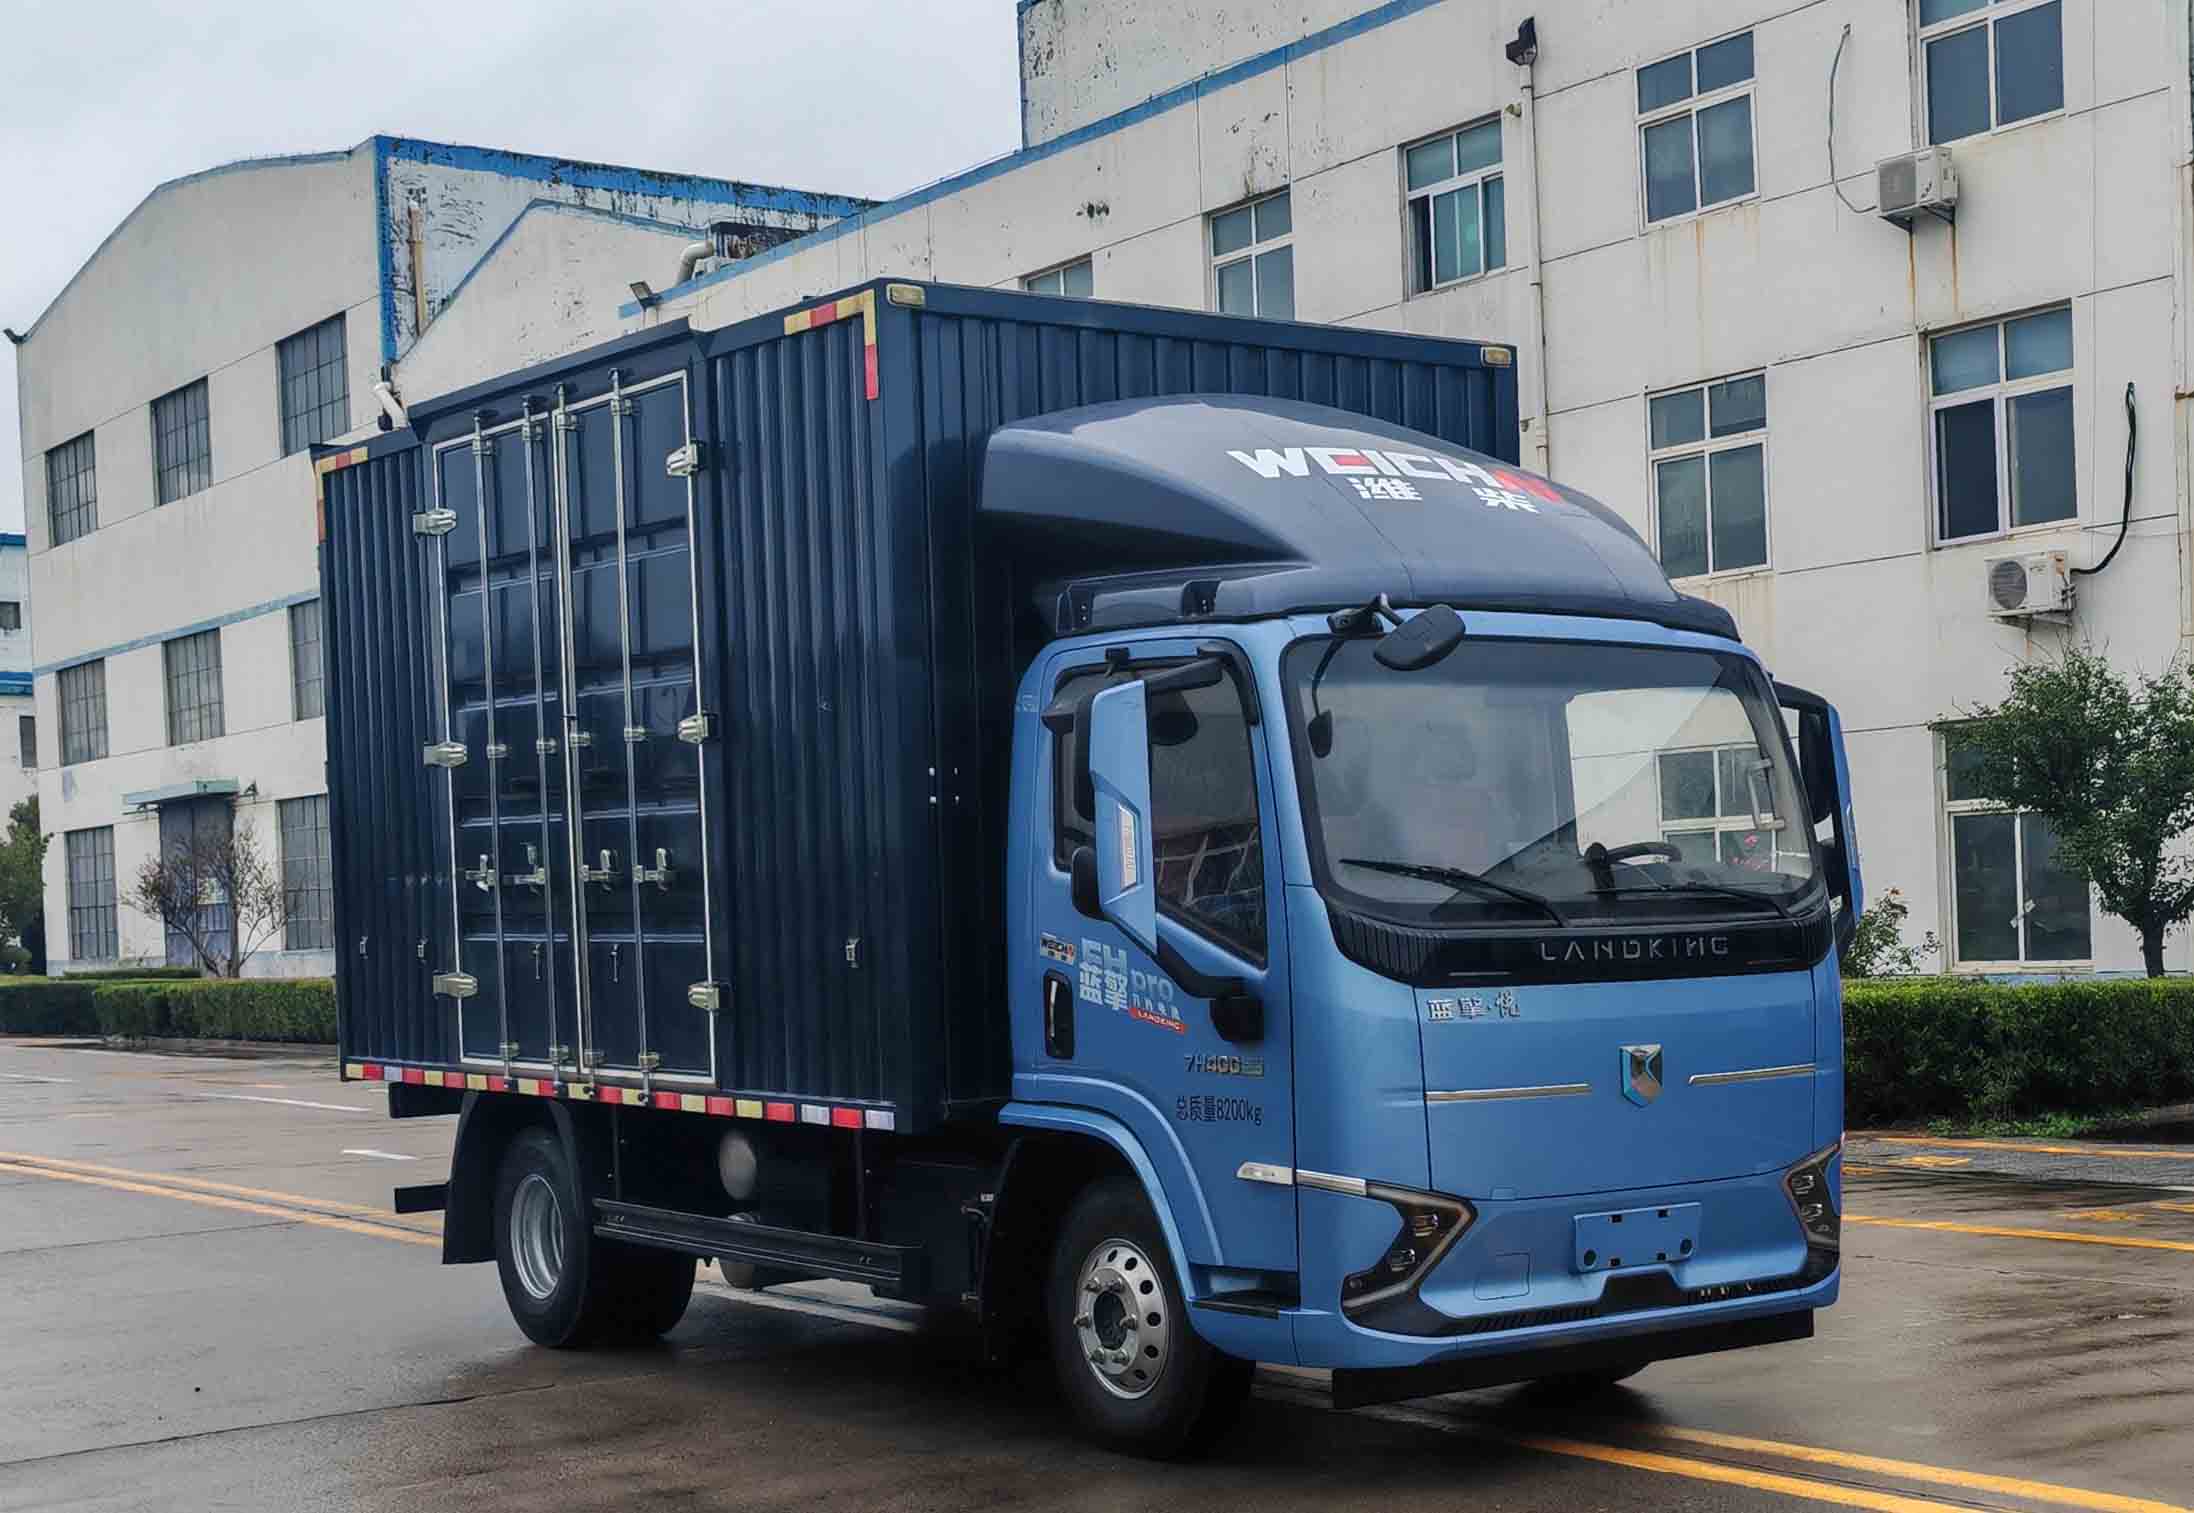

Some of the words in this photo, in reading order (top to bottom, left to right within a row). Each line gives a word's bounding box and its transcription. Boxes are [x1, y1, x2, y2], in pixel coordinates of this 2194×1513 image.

[1540, 936, 1729, 961] LANDKING
[1176, 1095, 1263, 1127] 总质量8200kg
